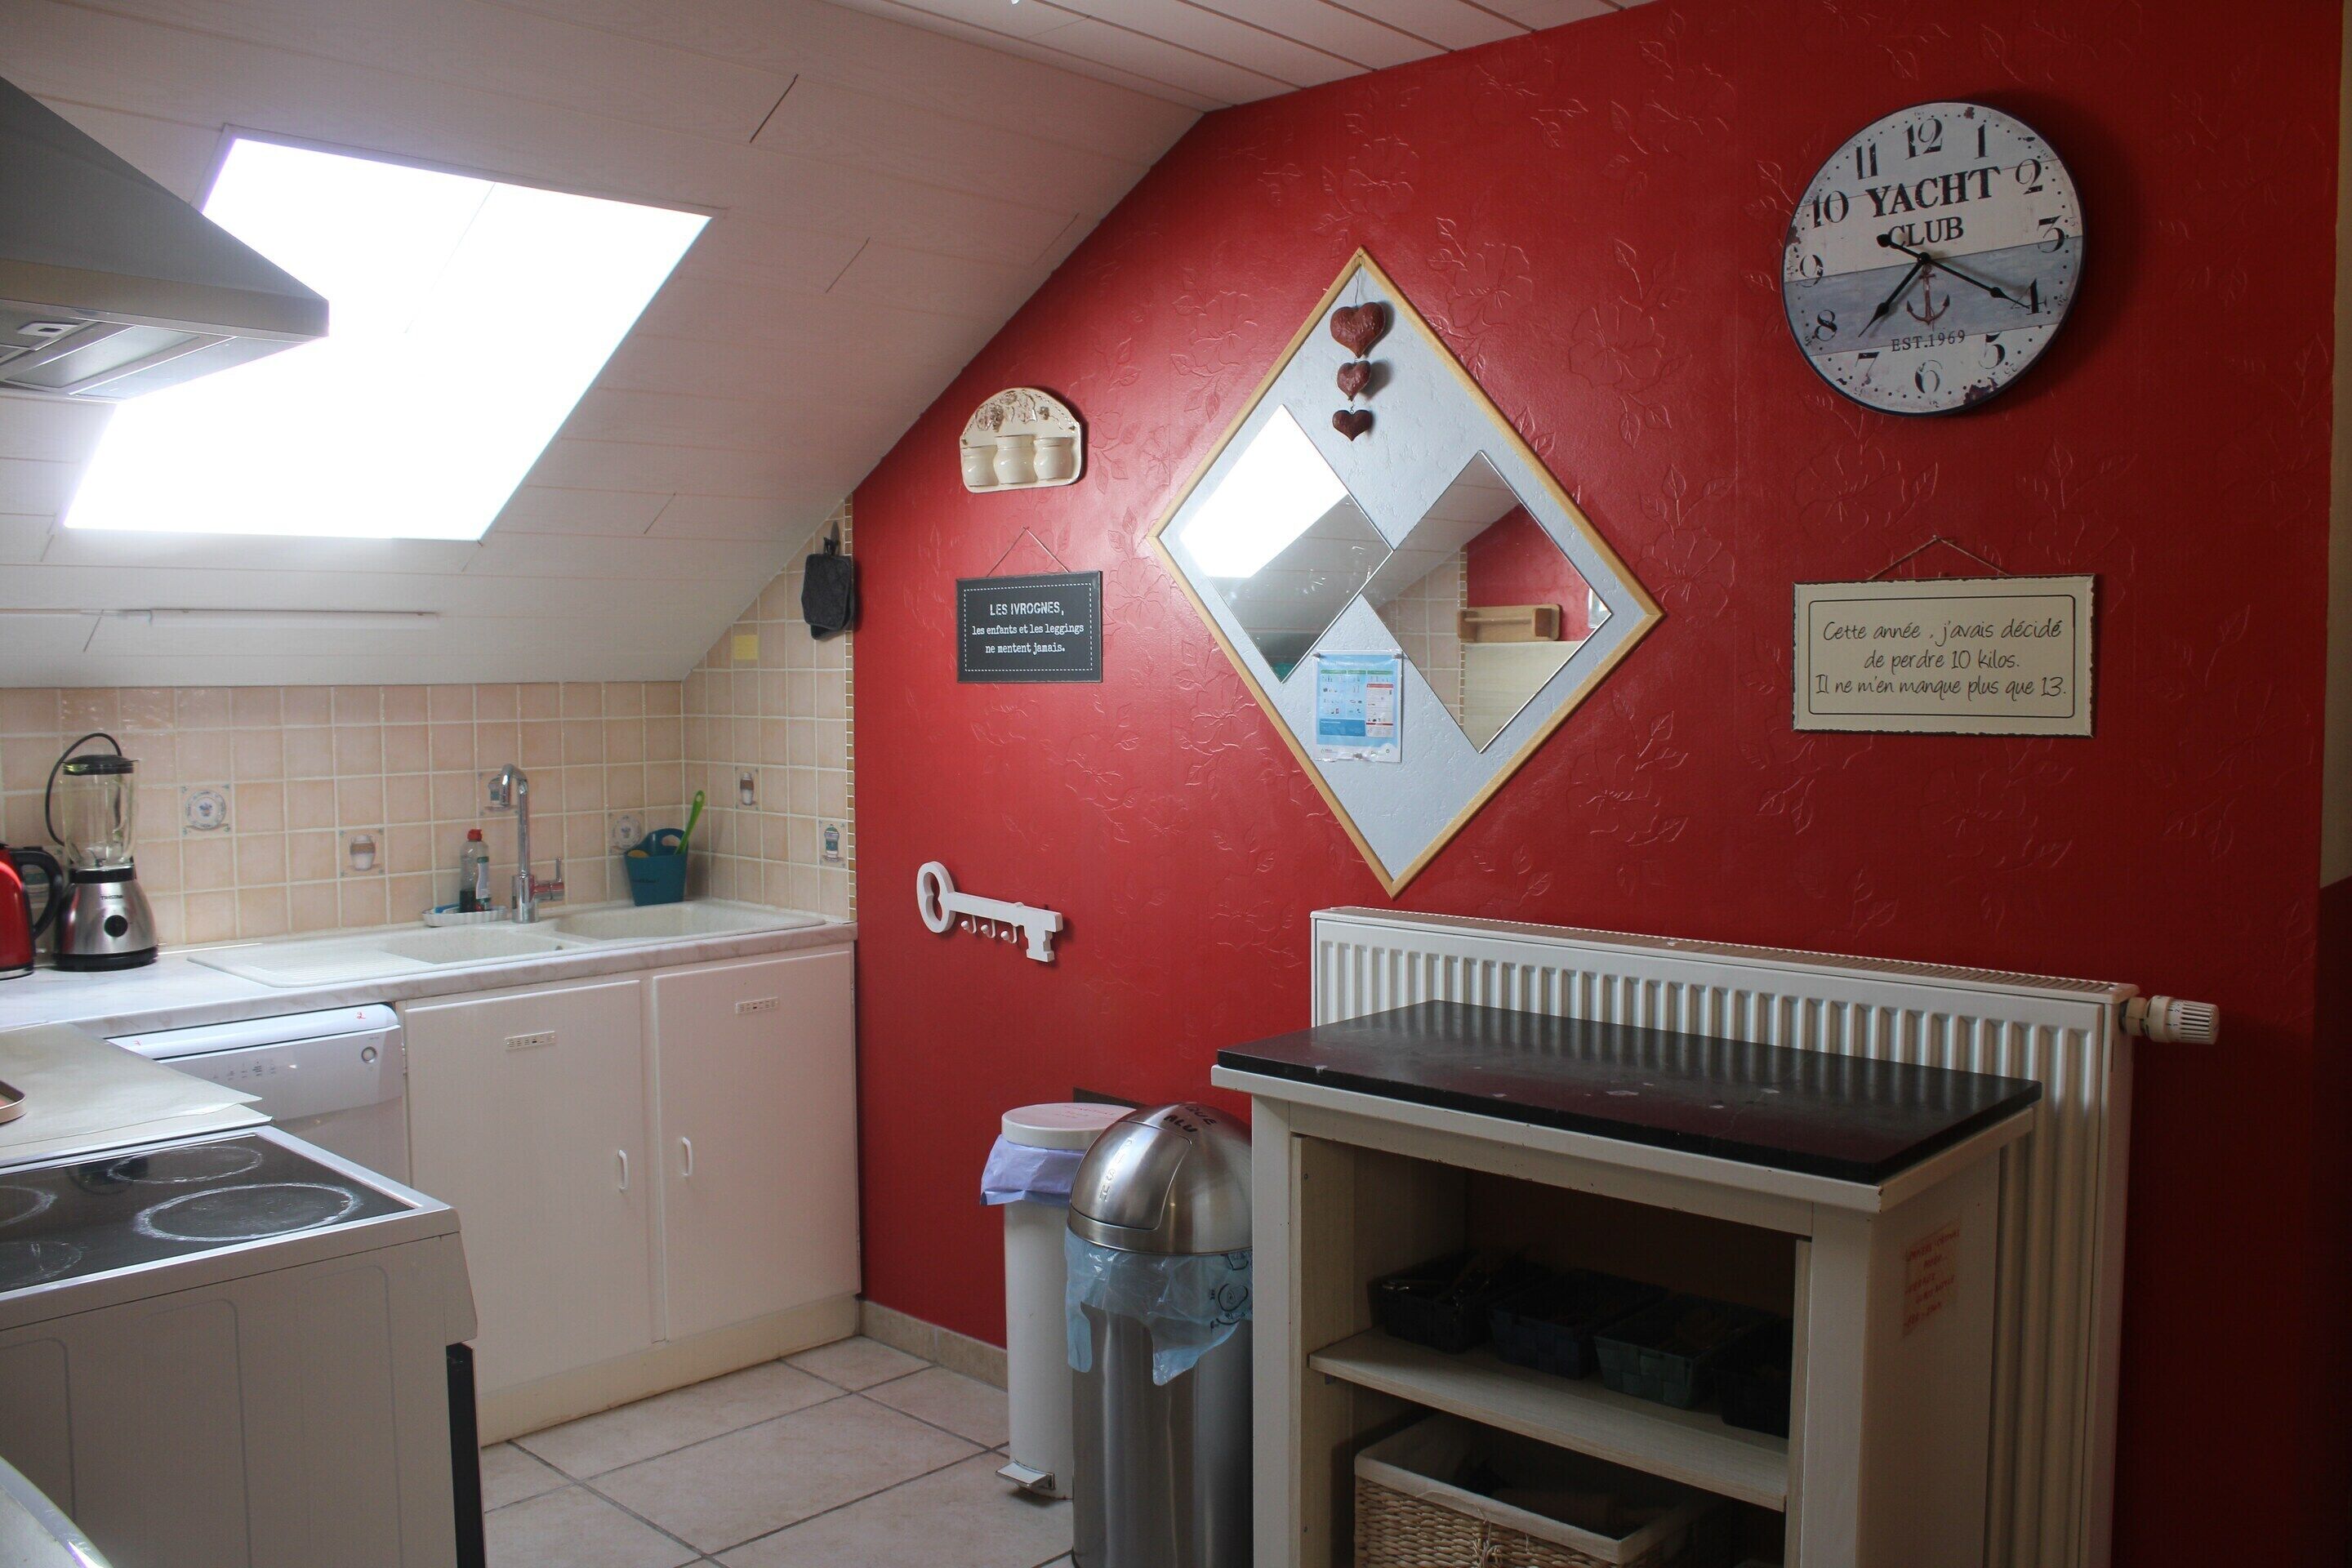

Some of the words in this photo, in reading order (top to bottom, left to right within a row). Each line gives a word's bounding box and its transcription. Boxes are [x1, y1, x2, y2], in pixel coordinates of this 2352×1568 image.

[1903, 118, 1944, 160] 12
[1973, 123, 1990, 160] 1
[1855, 142, 1879, 180] 11
[2014, 158, 2044, 195] 2
[1811, 190, 1850, 229] 10
[1865, 166, 2001, 219] YACHT
[1886, 216, 1964, 250] CLUB
[2036, 215, 2065, 254] 3
[1798, 254, 1824, 288] 9
[2010, 278, 2047, 316] 4
[1813, 310, 1838, 342] 8
[1854, 351, 1880, 386] 7
[1978, 332, 2007, 370] 5
[1913, 359, 1944, 394] 6
[990, 604, 1008, 616] LES
[1010, 601, 1065, 616] IVROGNES,
[972, 626, 985, 635] les
[987, 625, 1018, 635] enfants
[1019, 625, 1029, 635] et
[1030, 624, 1044, 635] les
[1045, 623, 1085, 635] leggings
[1822, 621, 1868, 641] Cette
[1873, 621, 1922, 639] année
[1935, 619, 1994, 648] j'avais
[2001, 617, 2064, 640] décidé
[985, 645, 996, 654] ne
[997, 644, 1031, 653] mentent
[1032, 642, 1066, 655] jamais.
[1864, 649, 1885, 669] de
[1891, 651, 1944, 675] perdre
[1951, 649, 1971, 670] 10
[1978, 649, 2020, 669] kilos.
[1815, 674, 1829, 695] Il
[1835, 679, 1853, 693] ne
[1857, 675, 1894, 694] m'en
[1900, 679, 1962, 702] manque
[1967, 676, 1999, 702] plus
[2005, 679, 2034, 702] que
[2041, 676, 2066, 697] 13.
